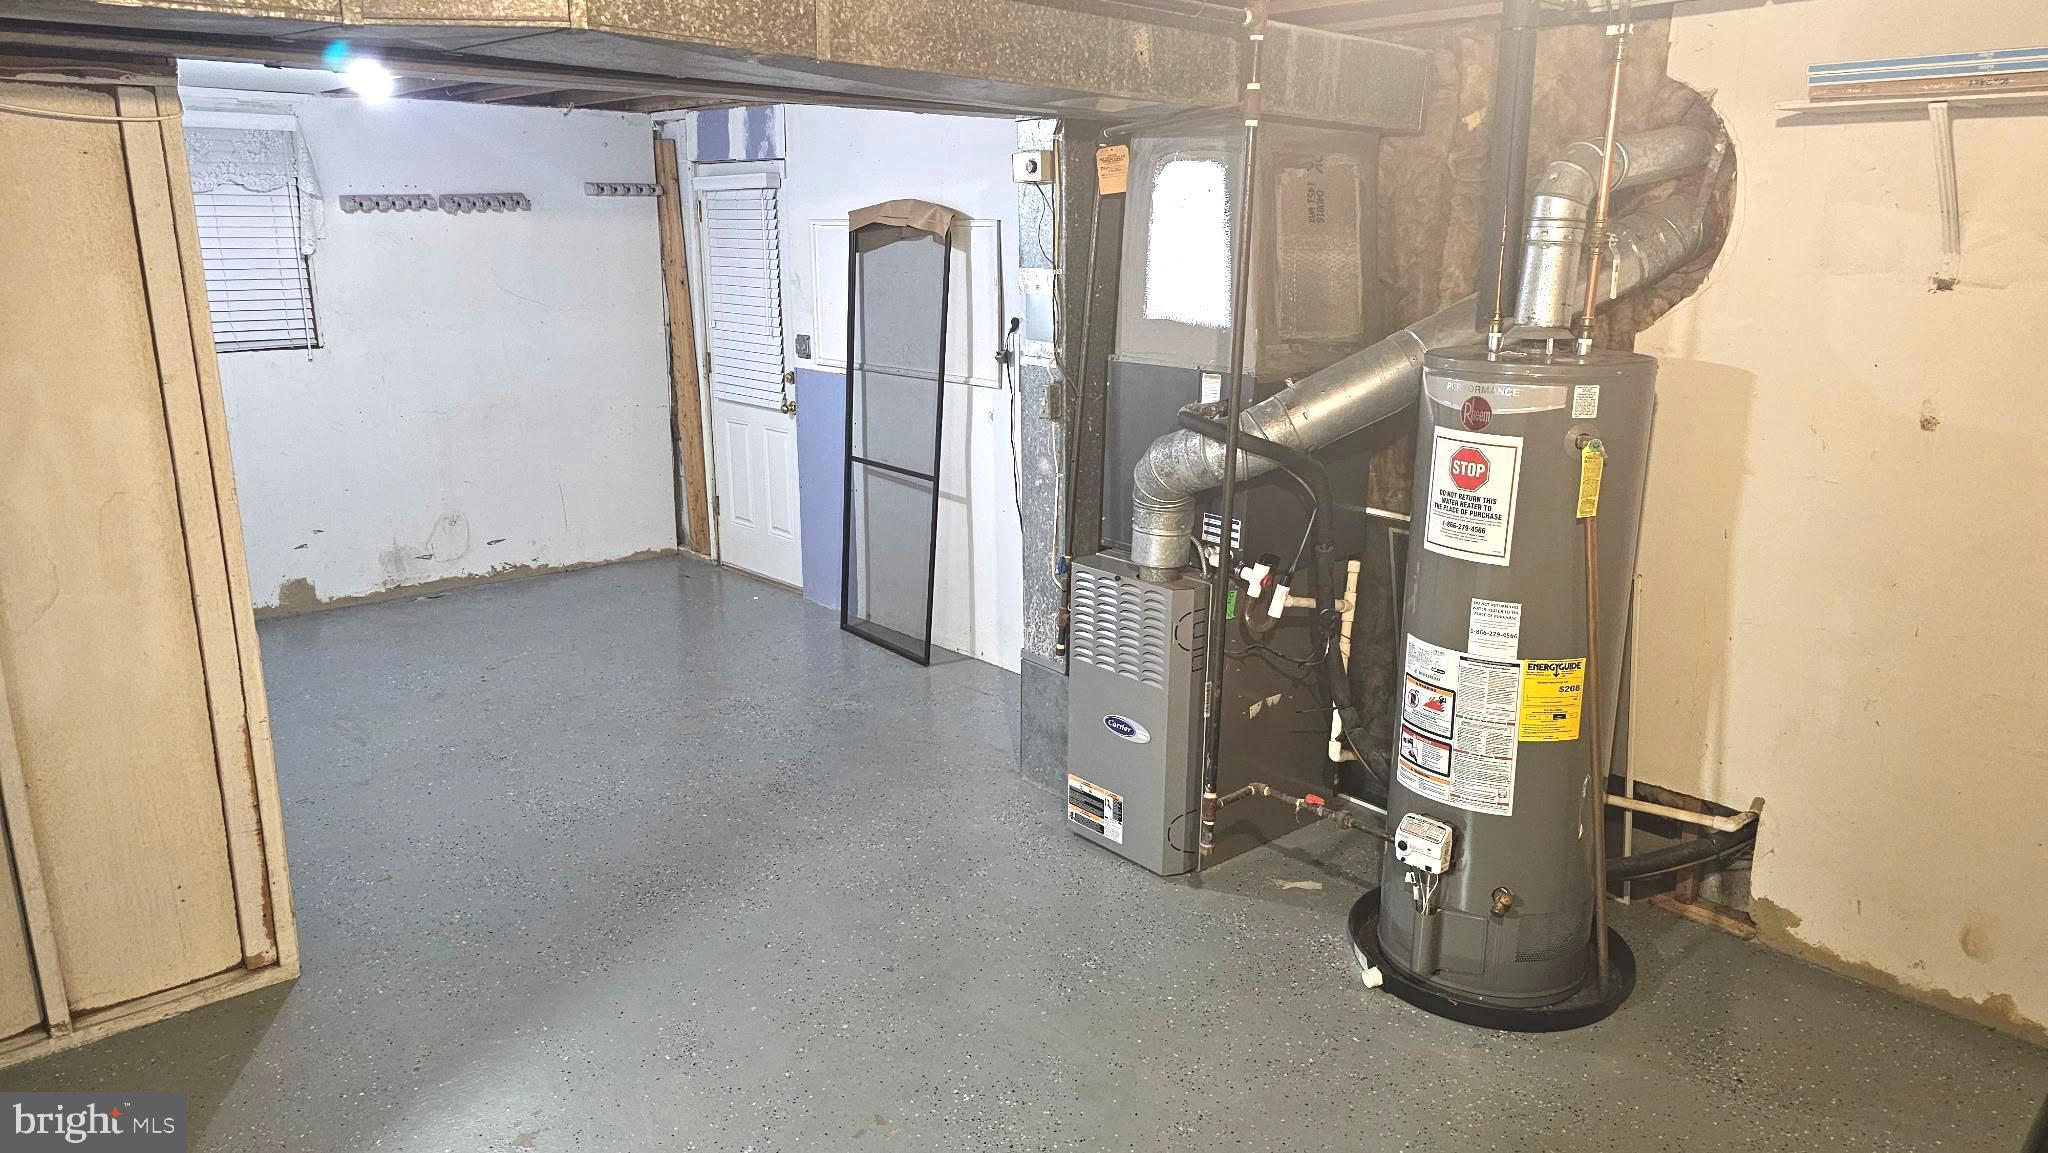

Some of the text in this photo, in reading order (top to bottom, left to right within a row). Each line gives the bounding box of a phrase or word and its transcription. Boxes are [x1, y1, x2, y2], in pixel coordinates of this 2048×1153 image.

[1446, 381, 1520, 397] PERORMANCE
[1463, 396, 1490, 425] Rheem
[1453, 459, 1486, 478] STOP
[1441, 497, 1458, 506] WATER
[1459, 501, 1482, 510] HEATER
[1458, 493, 1481, 502] RETURN
[1443, 504, 1459, 513] PLACE
[1469, 510, 1503, 520] PURCHASE
[1527, 661, 1582, 672] ENERGYGUIDE
[1107, 719, 1132, 733] Carrier
